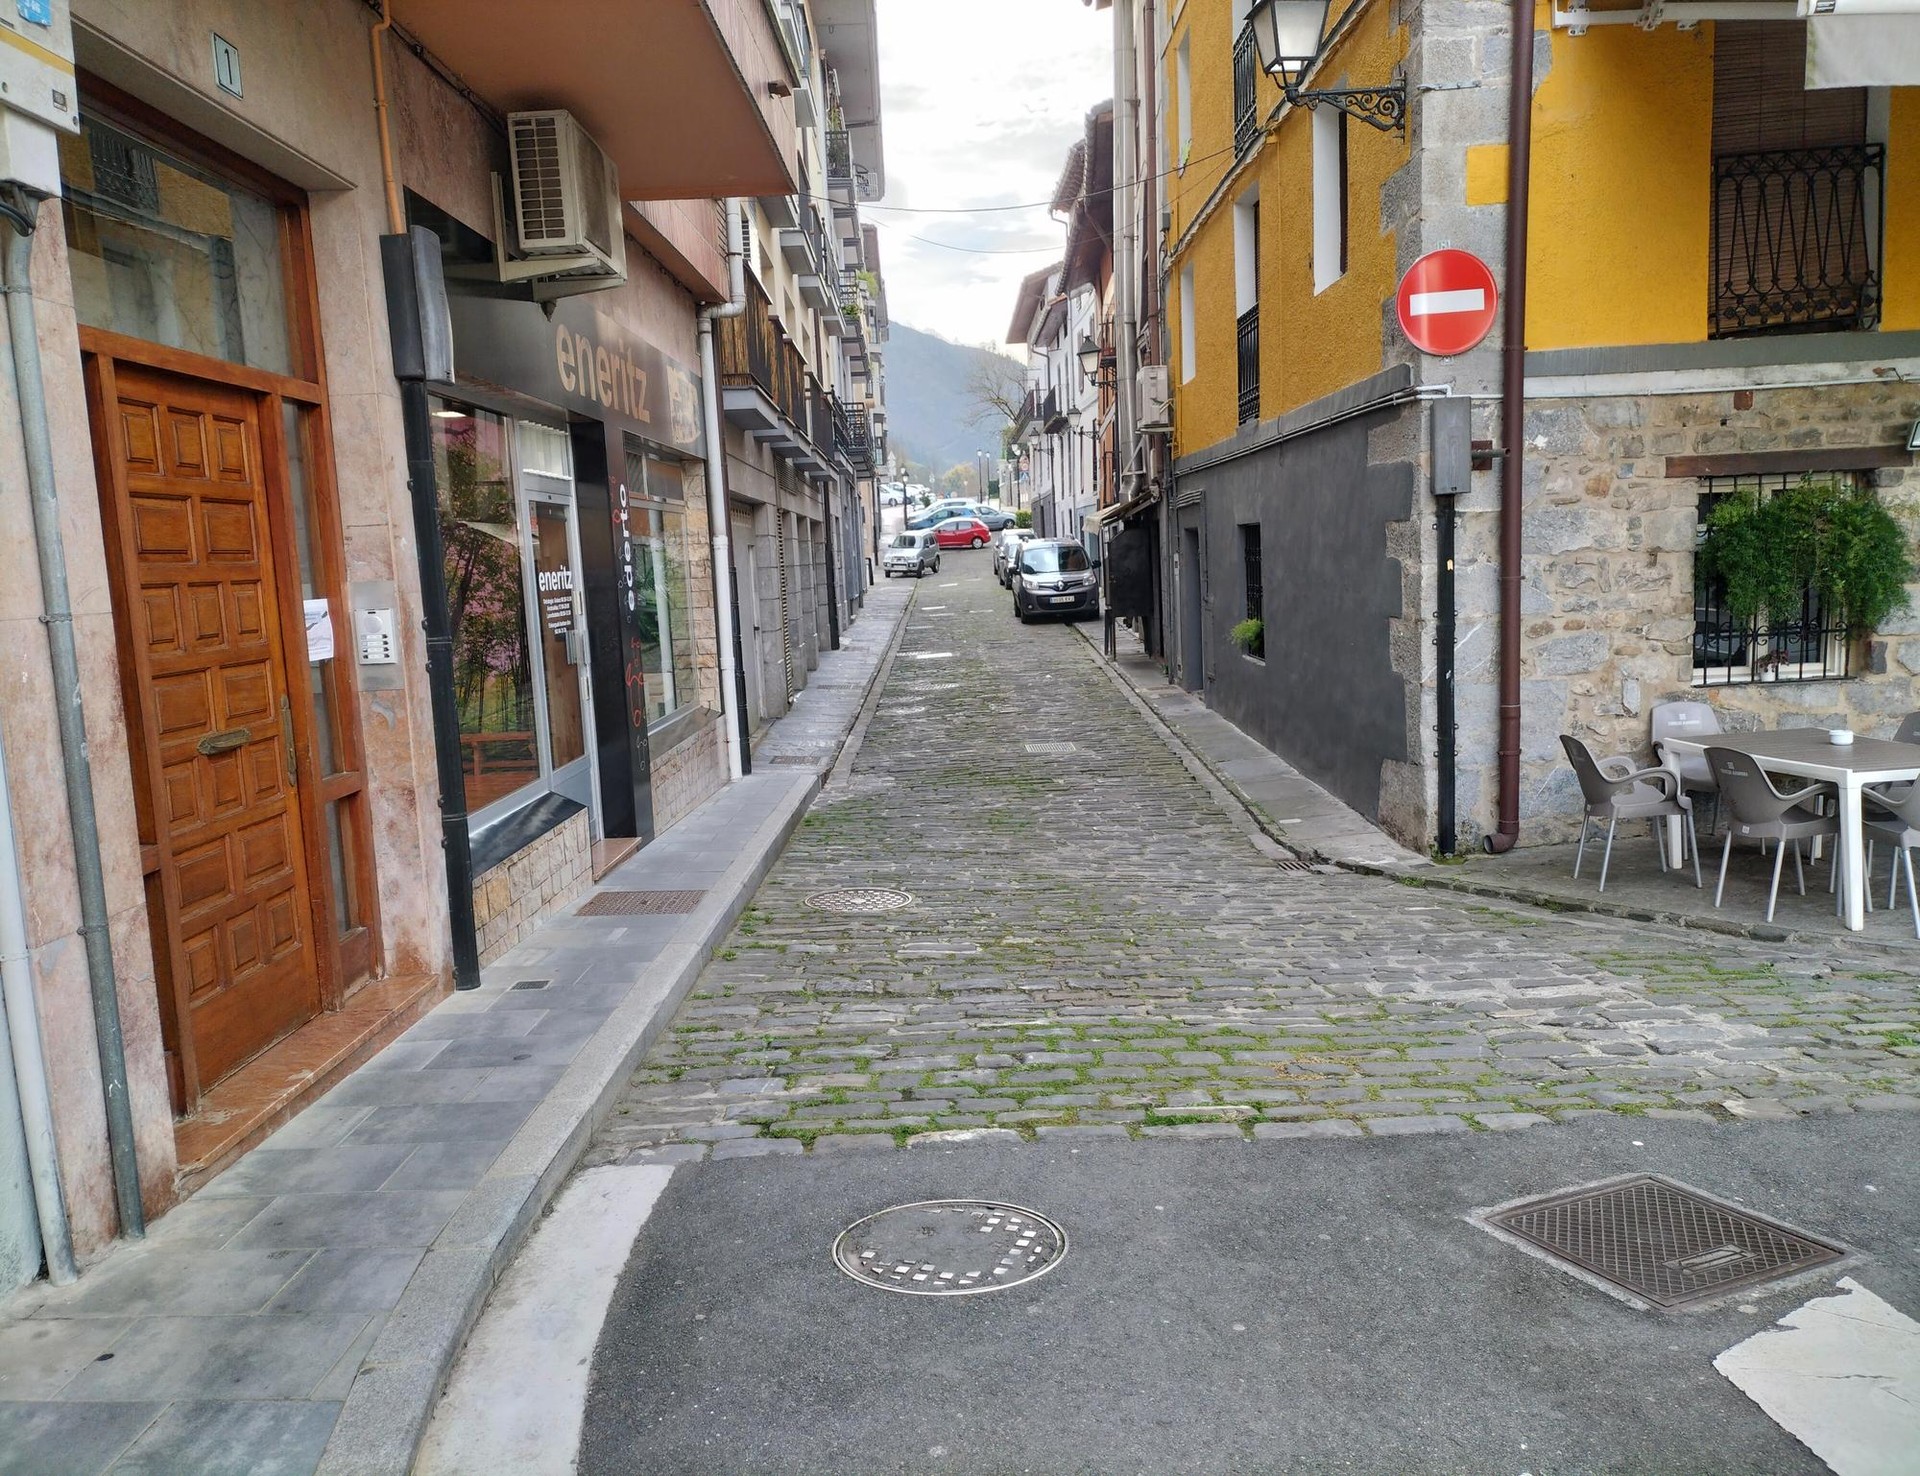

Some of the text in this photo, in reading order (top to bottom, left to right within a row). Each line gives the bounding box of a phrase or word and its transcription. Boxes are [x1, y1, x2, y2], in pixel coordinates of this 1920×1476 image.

[224, 47, 233, 85] 1
[556, 323, 650, 424] eneritz
[538, 564, 573, 591] eneritz
